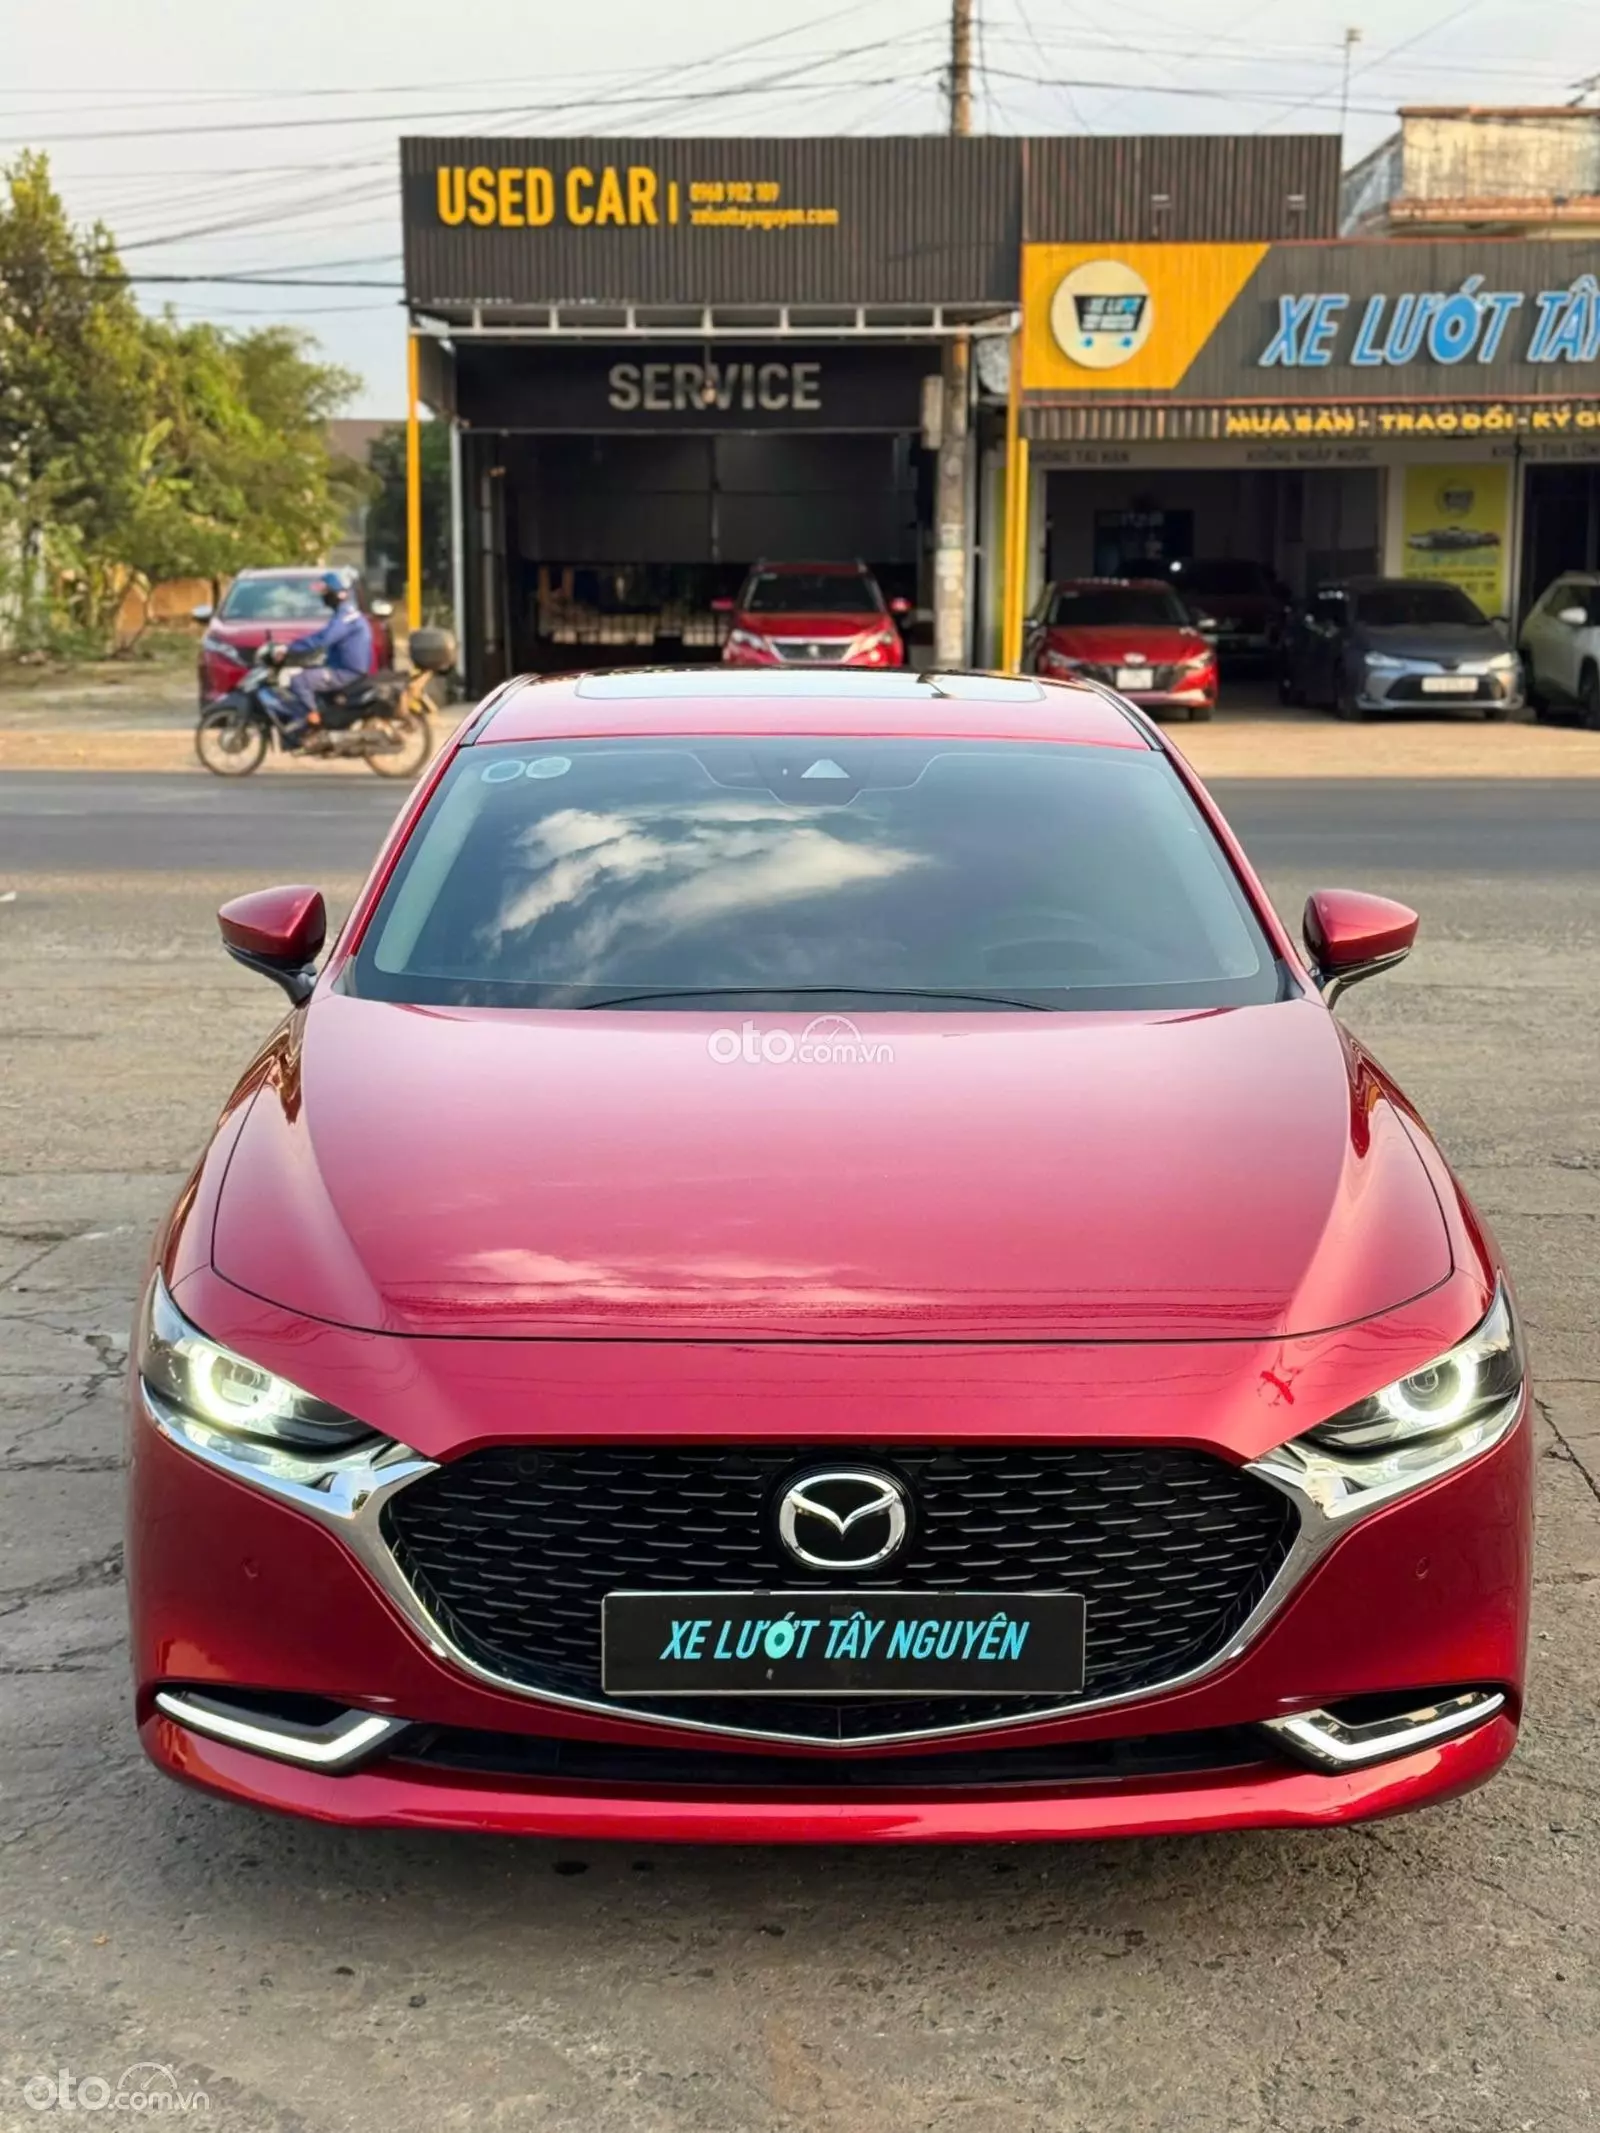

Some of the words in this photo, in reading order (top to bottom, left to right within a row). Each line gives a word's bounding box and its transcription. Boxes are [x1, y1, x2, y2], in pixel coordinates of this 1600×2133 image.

[437, 166, 555, 226] USED
[566, 166, 659, 226] CAR
[1258, 293, 1350, 366] XE
[1351, 274, 1524, 366] LƯỚT
[608, 363, 822, 410] SERVICE
[1227, 415, 1291, 433] MUA
[1378, 413, 1458, 432] TRAO
[1532, 404, 1571, 428] KÝ
[659, 1620, 712, 1659] XE
[713, 1612, 820, 1659] LƯỚT
[824, 1611, 886, 1659] TÂY
[886, 1611, 1030, 1660] NGUYÊN
